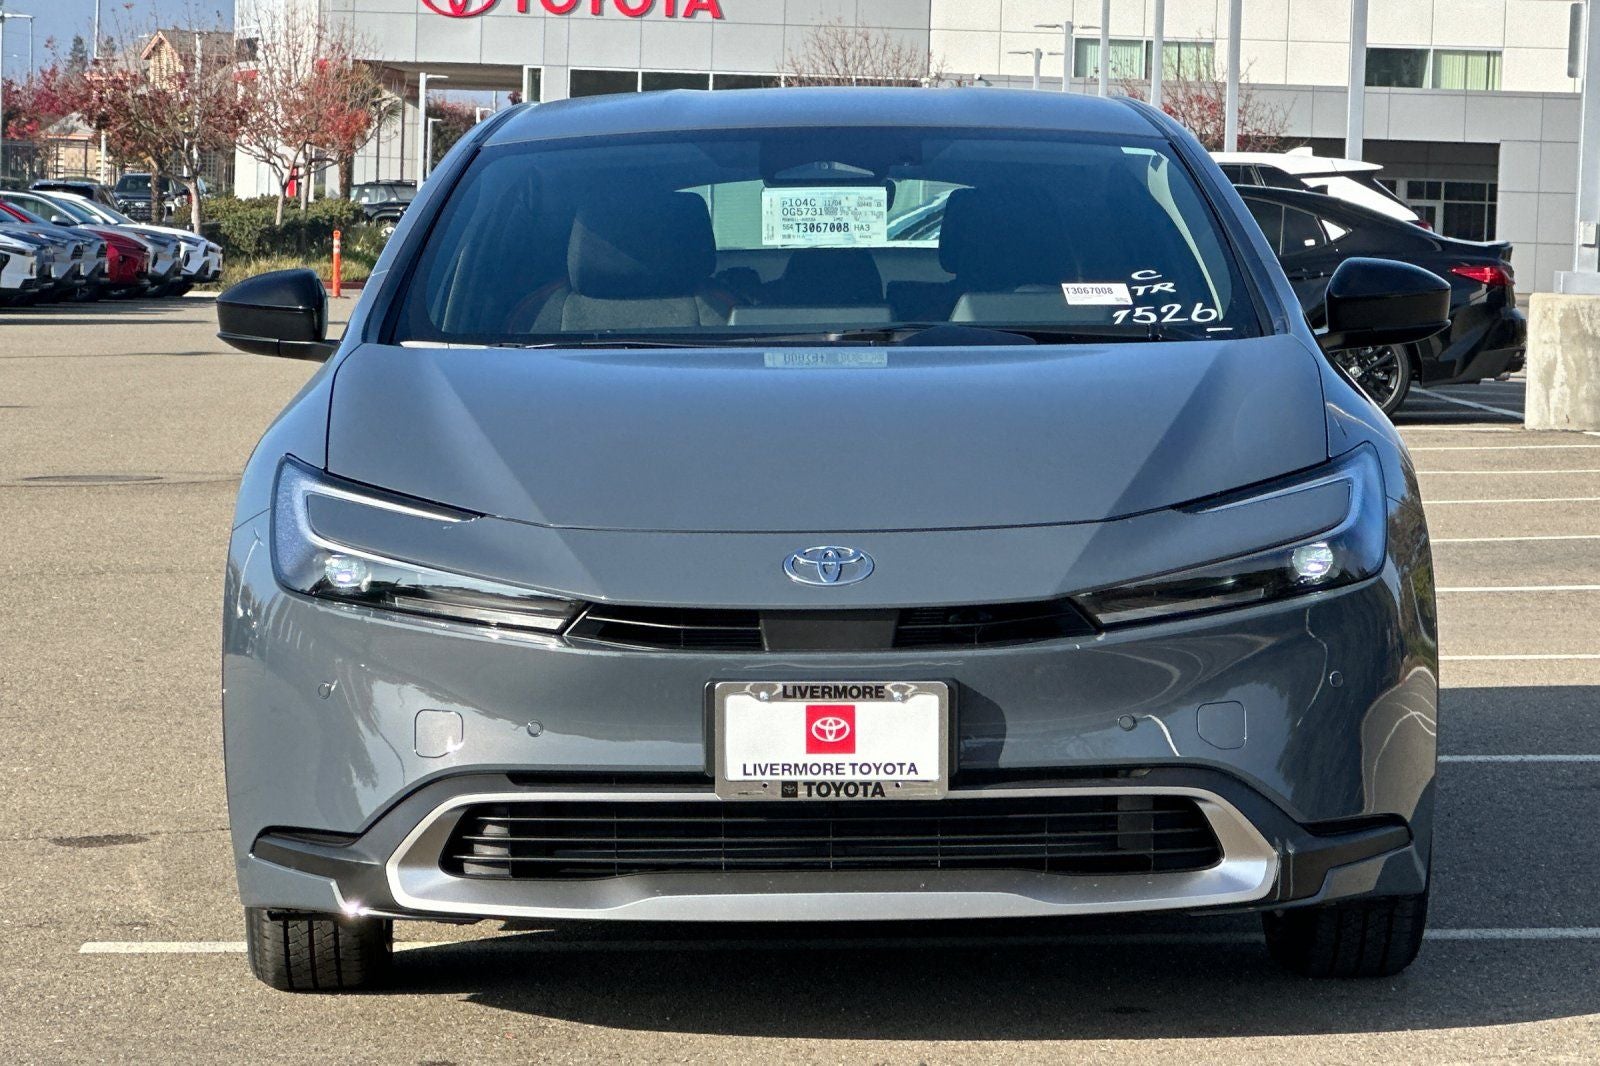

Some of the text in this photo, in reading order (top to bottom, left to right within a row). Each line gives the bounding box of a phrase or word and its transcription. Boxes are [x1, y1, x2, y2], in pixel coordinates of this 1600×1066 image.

[795, 223, 850, 233] T3067008
[1064, 287, 1114, 295] T3067008
[1131, 282, 1177, 296] TR
[782, 685, 885, 699] LIVERMORE
[742, 762, 919, 777] LIVERMORE TOYOTA
[803, 781, 886, 798] TOYOTA
